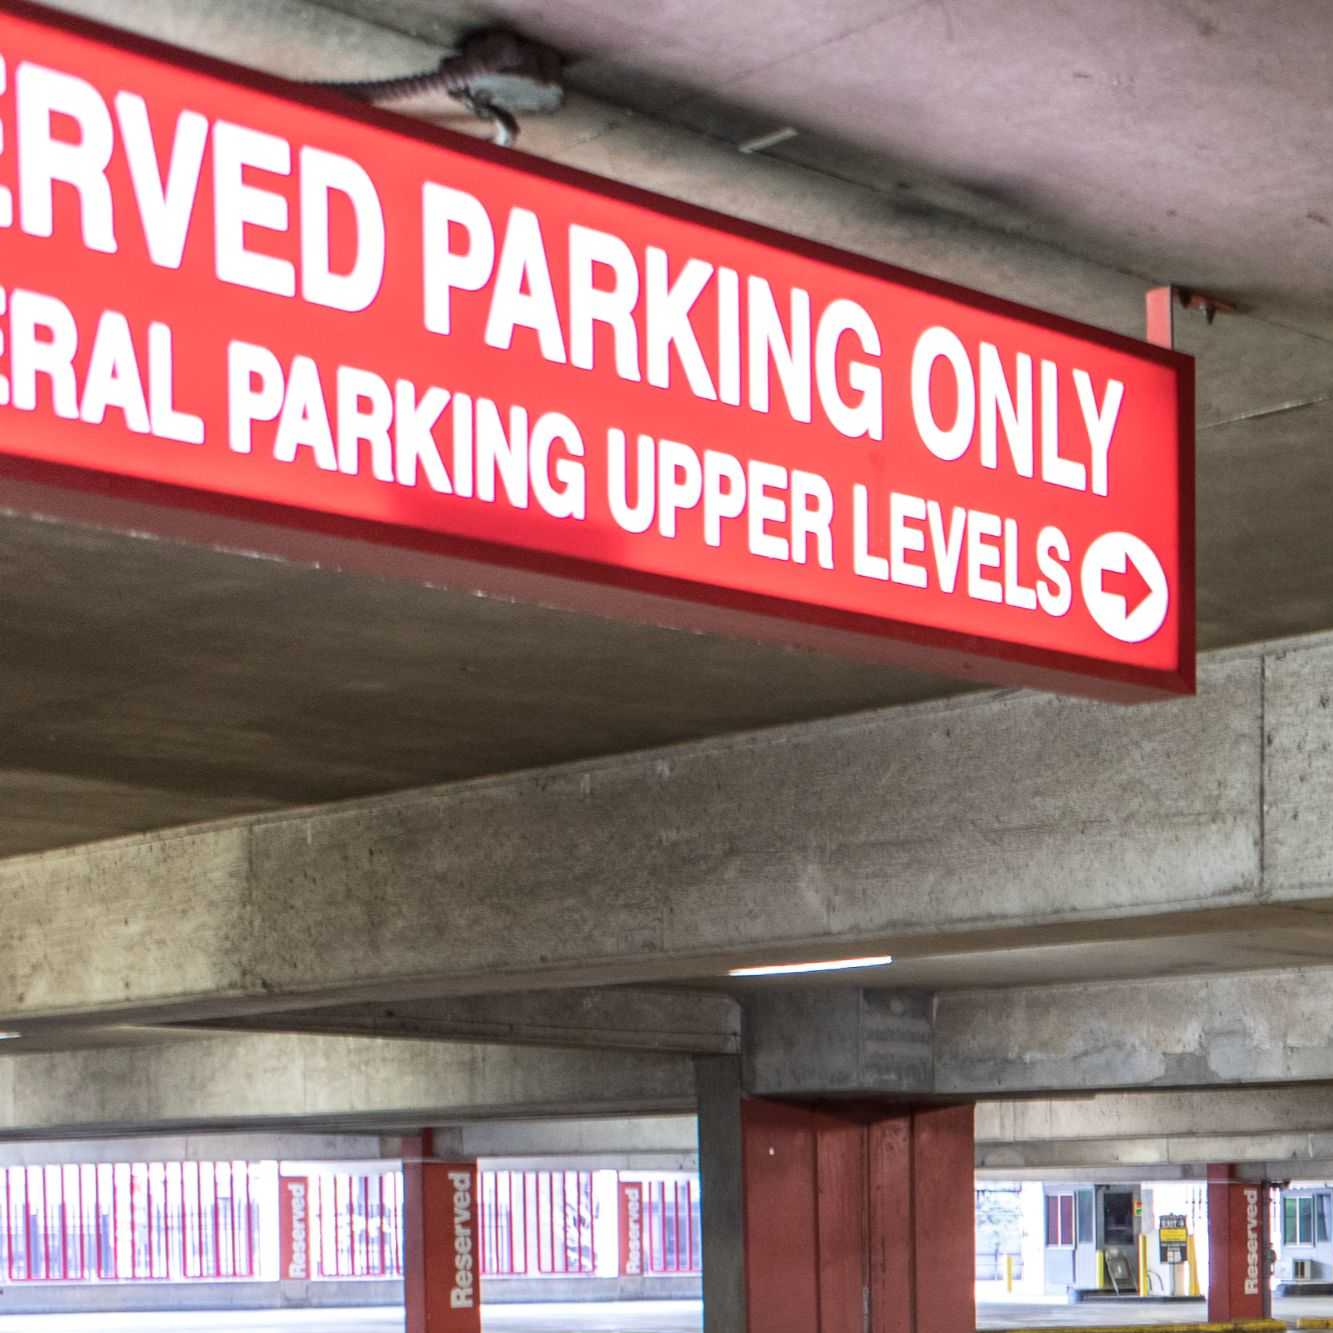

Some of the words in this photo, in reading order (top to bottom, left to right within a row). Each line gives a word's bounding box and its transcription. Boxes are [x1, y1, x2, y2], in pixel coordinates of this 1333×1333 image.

[0, 52, 386, 313] RVED
[423, 181, 883, 442] PARKING
[911, 325, 1125, 497] ONLY
[0, 285, 205, 445] RAL
[228, 340, 586, 520] PARKING
[606, 427, 835, 570] UPPER
[853, 484, 1072, 617] LEVELS
[287, 1183, 305, 1278] Reserved
[449, 1171, 473, 1309] Reserved
[625, 1188, 640, 1274] Reserved
[1244, 1187, 1258, 1295] Reserved
